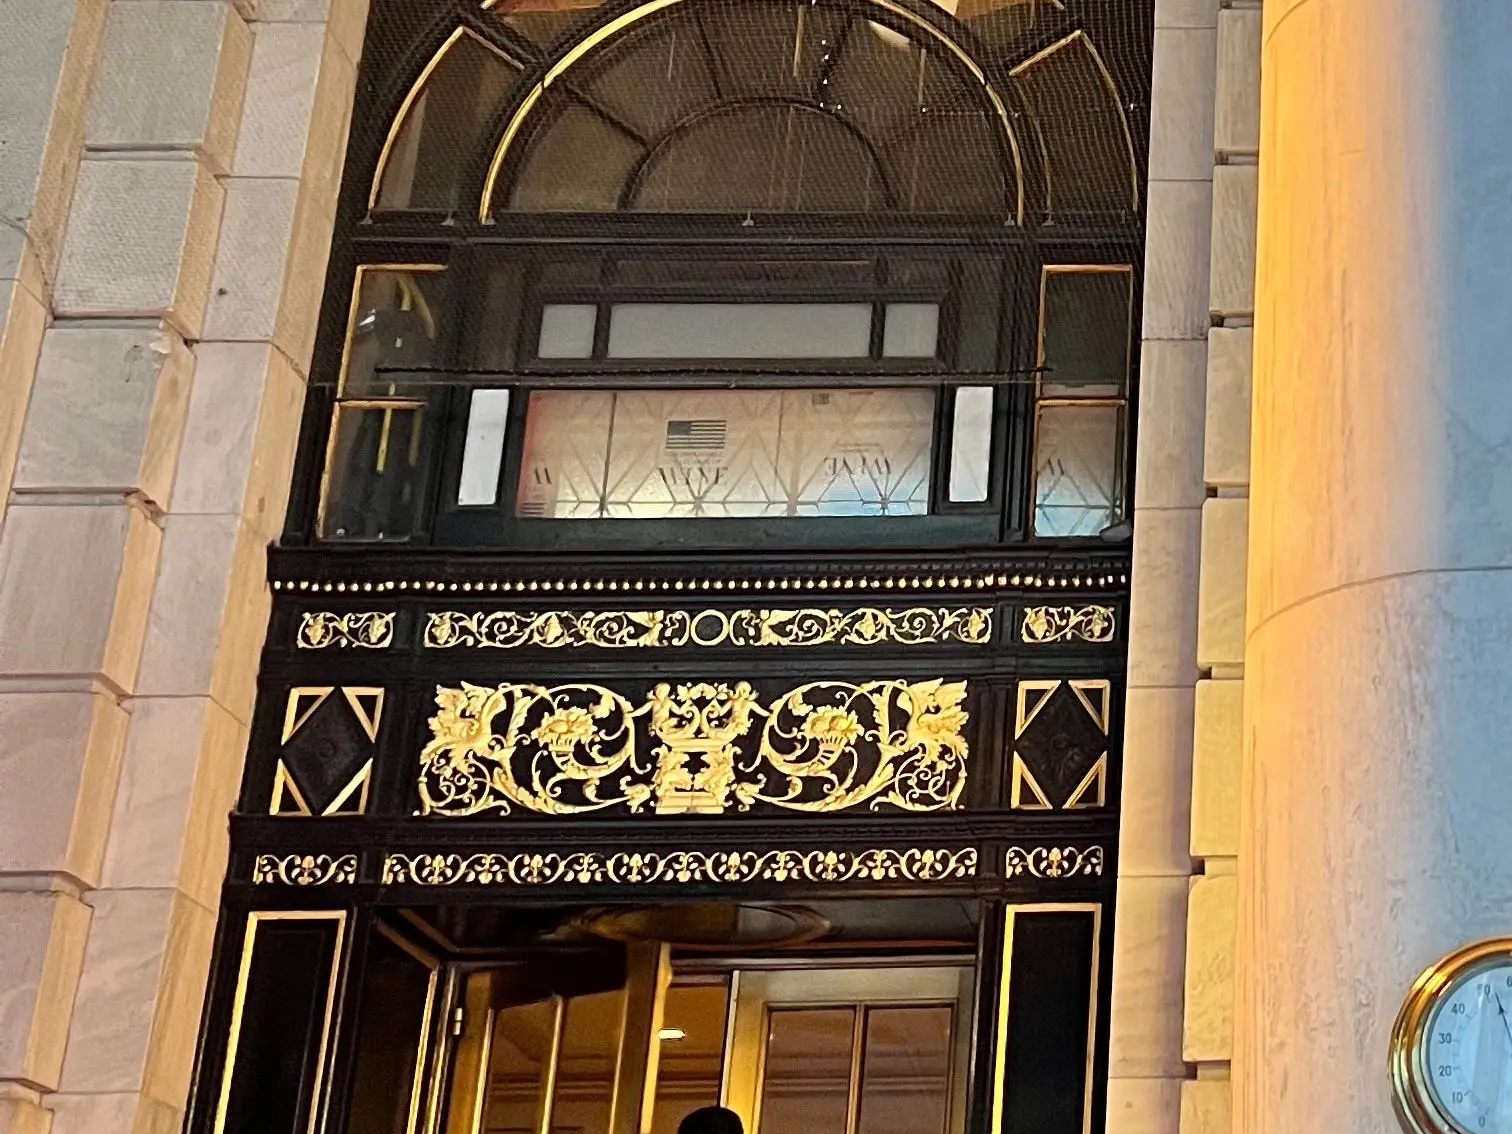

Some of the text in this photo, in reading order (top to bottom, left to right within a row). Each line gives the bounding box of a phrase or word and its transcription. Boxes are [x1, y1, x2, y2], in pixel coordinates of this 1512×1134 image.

[1451, 1002, 1466, 1015] 40
[1438, 1032, 1452, 1044] 30
[1439, 1065, 1452, 1077] 20
[1452, 1091, 1463, 1104] 10
[1478, 1116, 1486, 1128] 0
